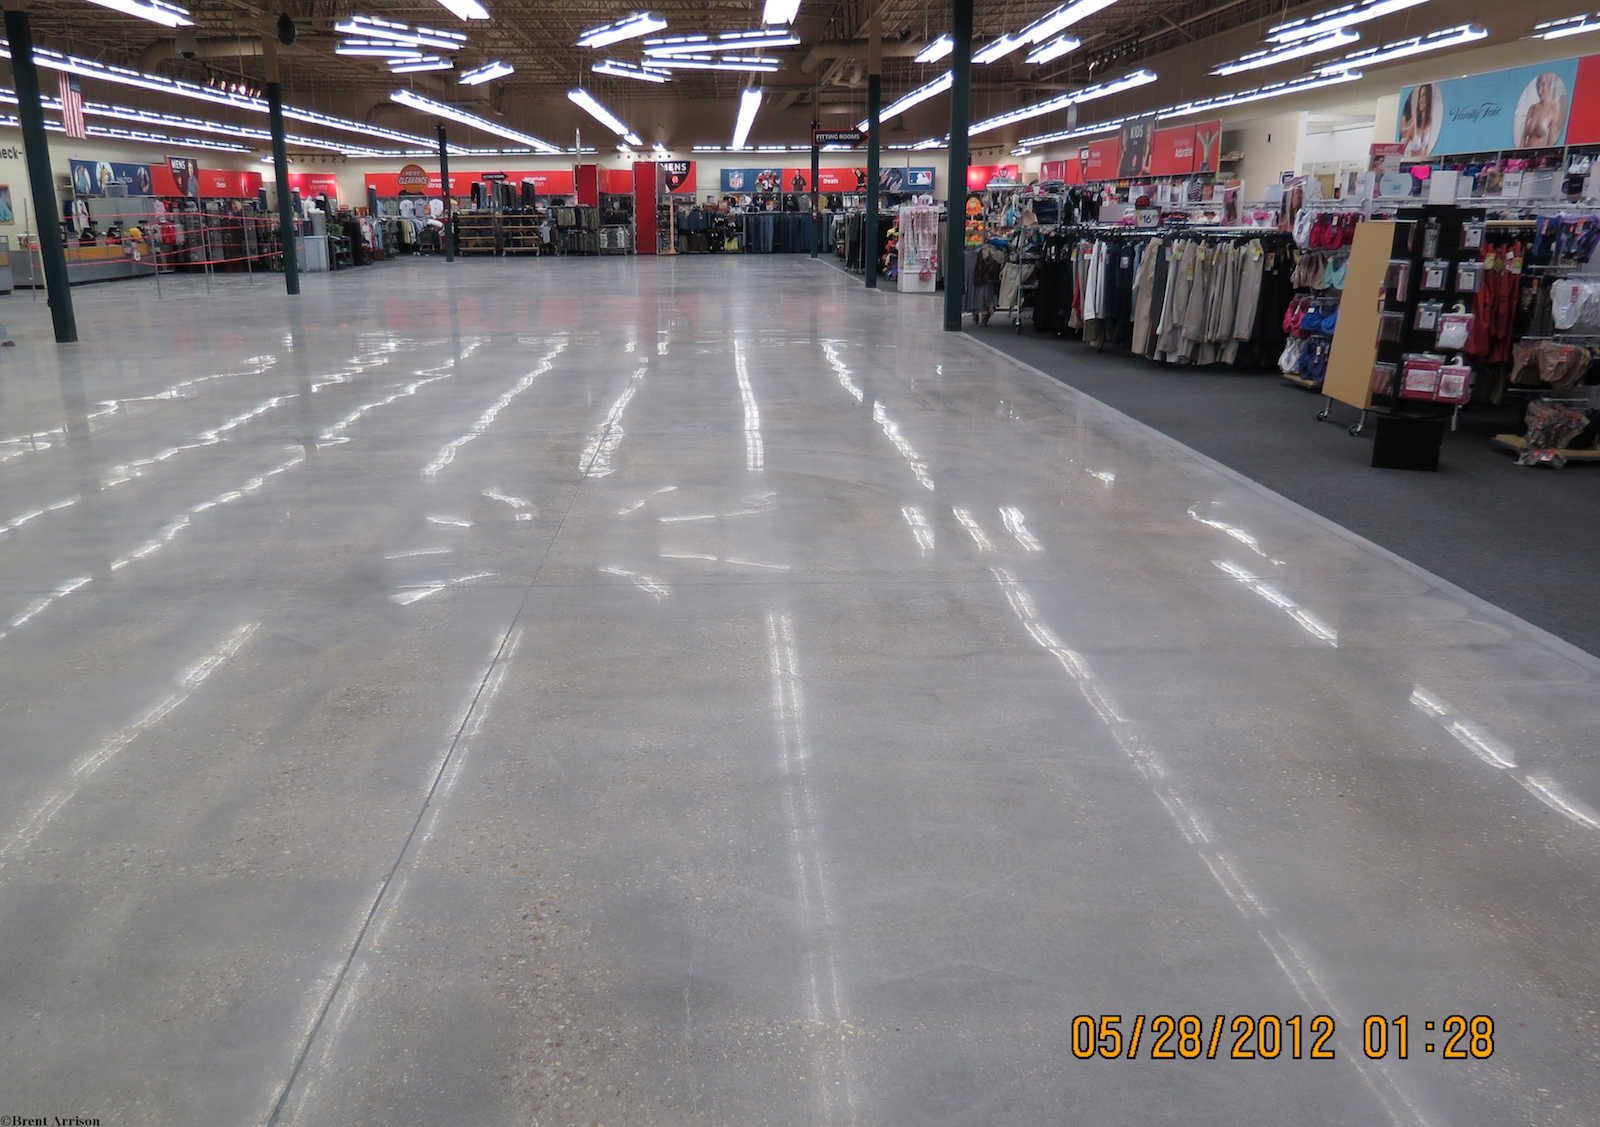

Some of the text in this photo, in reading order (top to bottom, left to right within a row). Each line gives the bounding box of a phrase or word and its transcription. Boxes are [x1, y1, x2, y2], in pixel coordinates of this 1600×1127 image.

[1449, 102, 1502, 123] Vanity Fair
[816, 133, 860, 141] FITTING ROOMS
[1130, 124, 1143, 139] KIDS
[0, 146, 22, 160] eck-
[1174, 147, 1193, 158] Adorable
[171, 159, 186, 170] MENS
[398, 176, 428, 185] CLEARANCE
